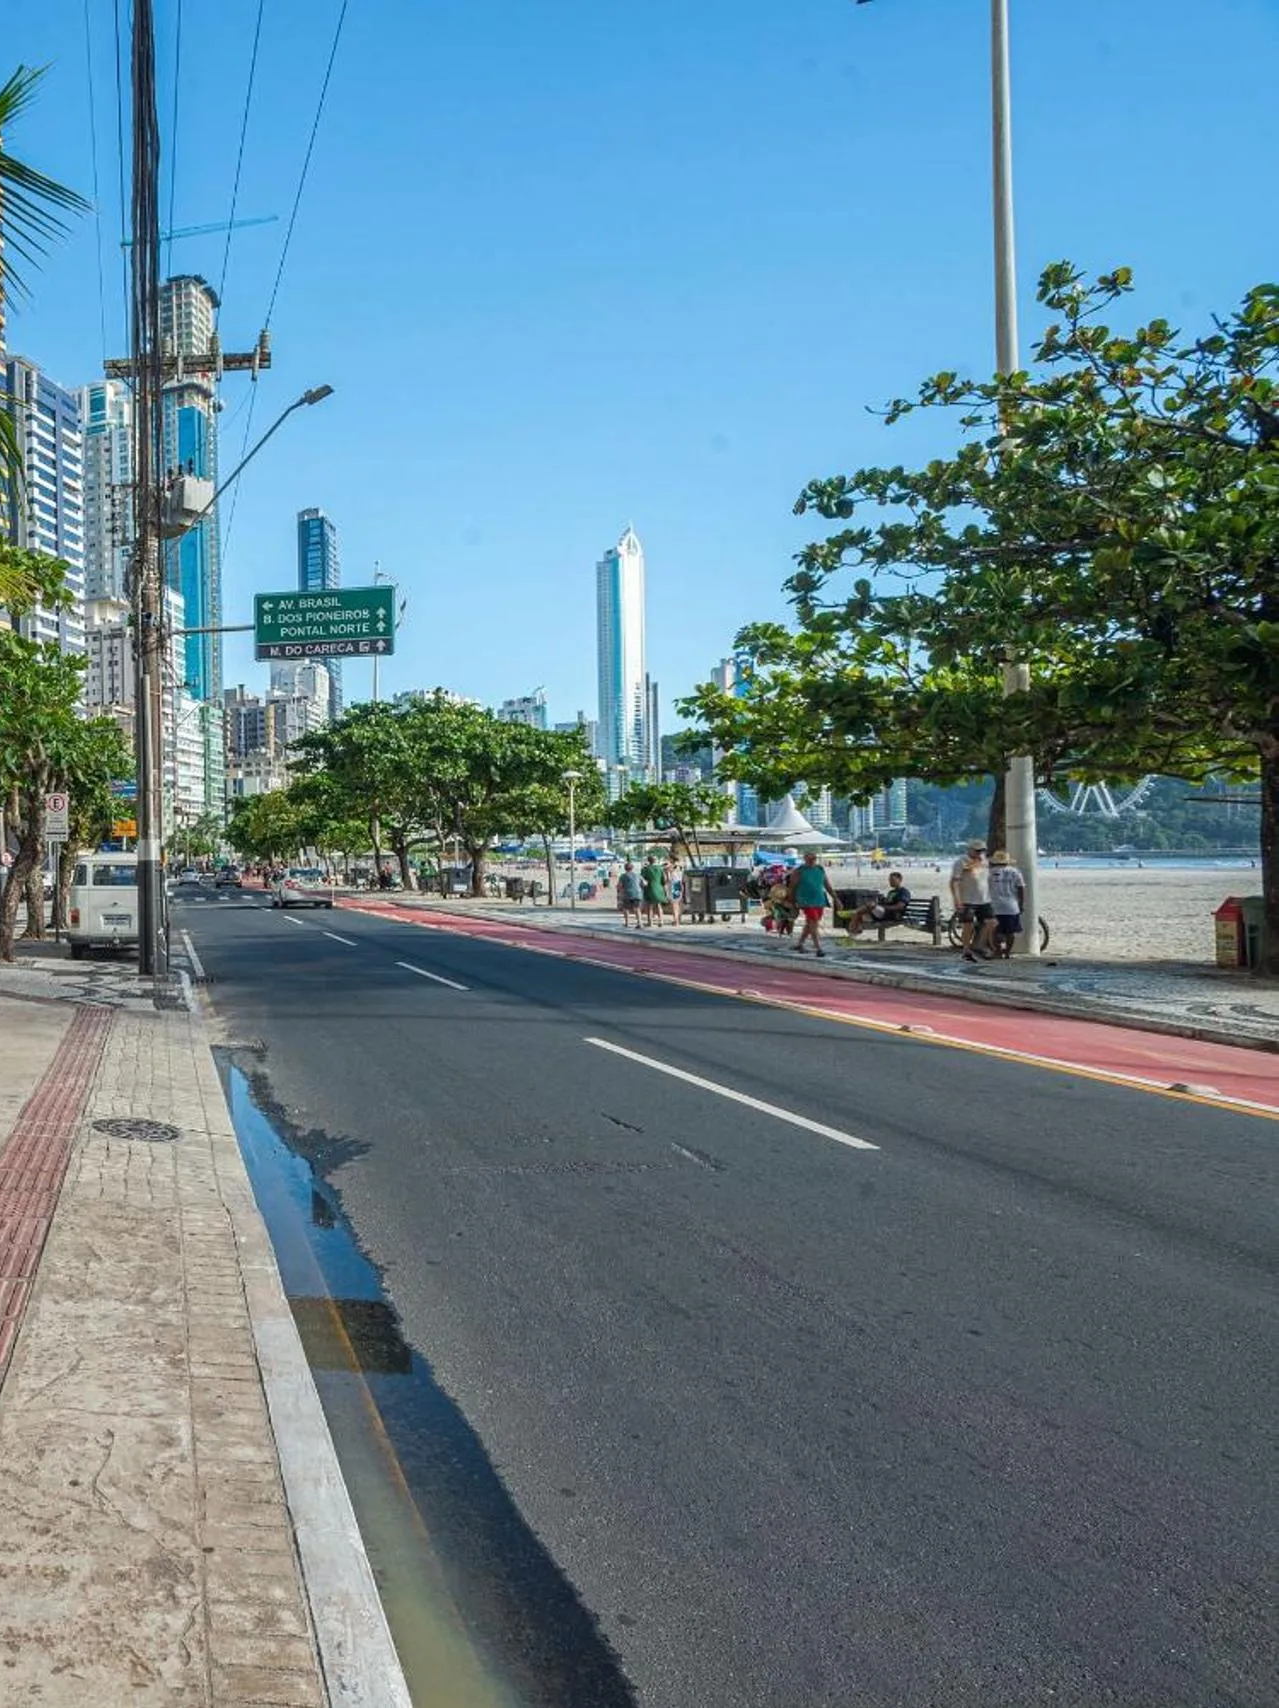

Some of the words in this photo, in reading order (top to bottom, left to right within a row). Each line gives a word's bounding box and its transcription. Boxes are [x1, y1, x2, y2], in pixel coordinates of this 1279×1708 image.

[278, 600, 296, 610] AV.
[299, 597, 342, 609] BRASIL
[278, 612, 303, 624] DOS
[306, 609, 370, 622] PIONEIROS
[280, 625, 327, 637] PONTAL
[329, 622, 370, 634] NORTE
[285, 645, 303, 656] DO
[305, 642, 354, 655] CARECA
